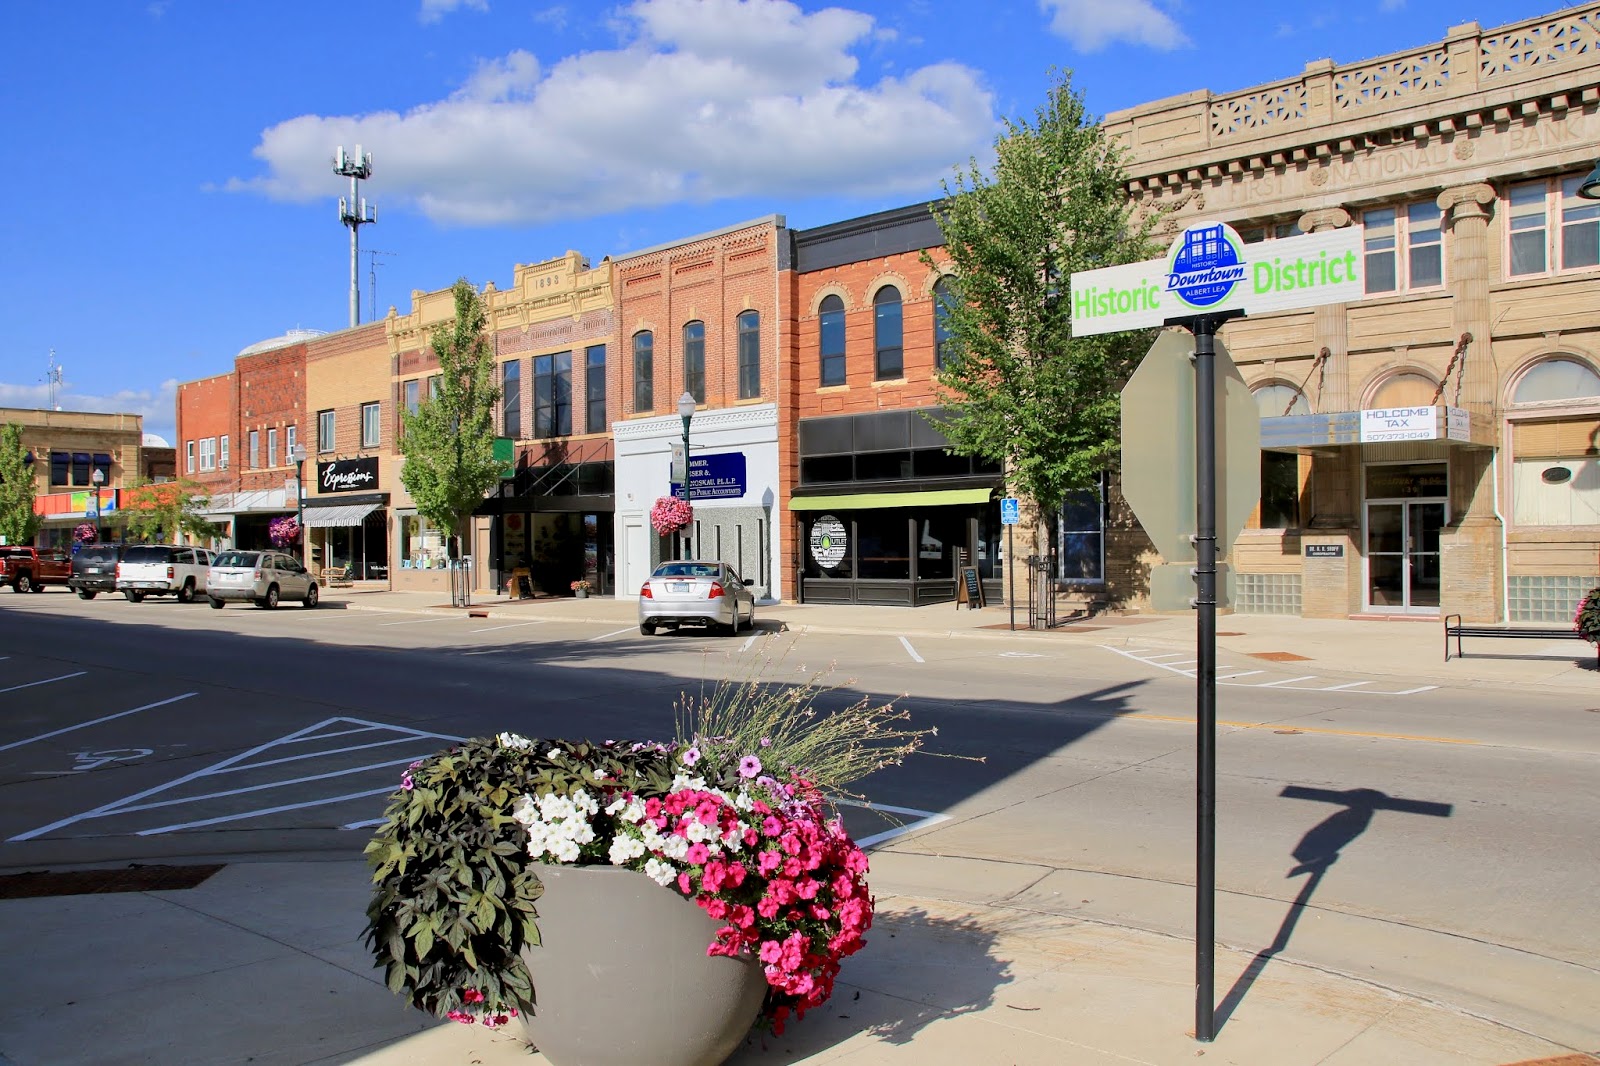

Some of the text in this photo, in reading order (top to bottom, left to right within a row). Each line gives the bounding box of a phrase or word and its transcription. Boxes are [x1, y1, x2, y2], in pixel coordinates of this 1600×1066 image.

[1230, 119, 1584, 202] FIRST NATIONAL BANK
[1191, 260, 1218, 268] HISTORIC
[1075, 249, 1357, 320] Historic District
[1168, 266, 1244, 289] Downtown
[1185, 285, 1226, 297] ALBERT LEA
[1366, 407, 1429, 419] HOLCOMB
[1384, 419, 1410, 428] TAX
[322, 463, 374, 491] Expressions
